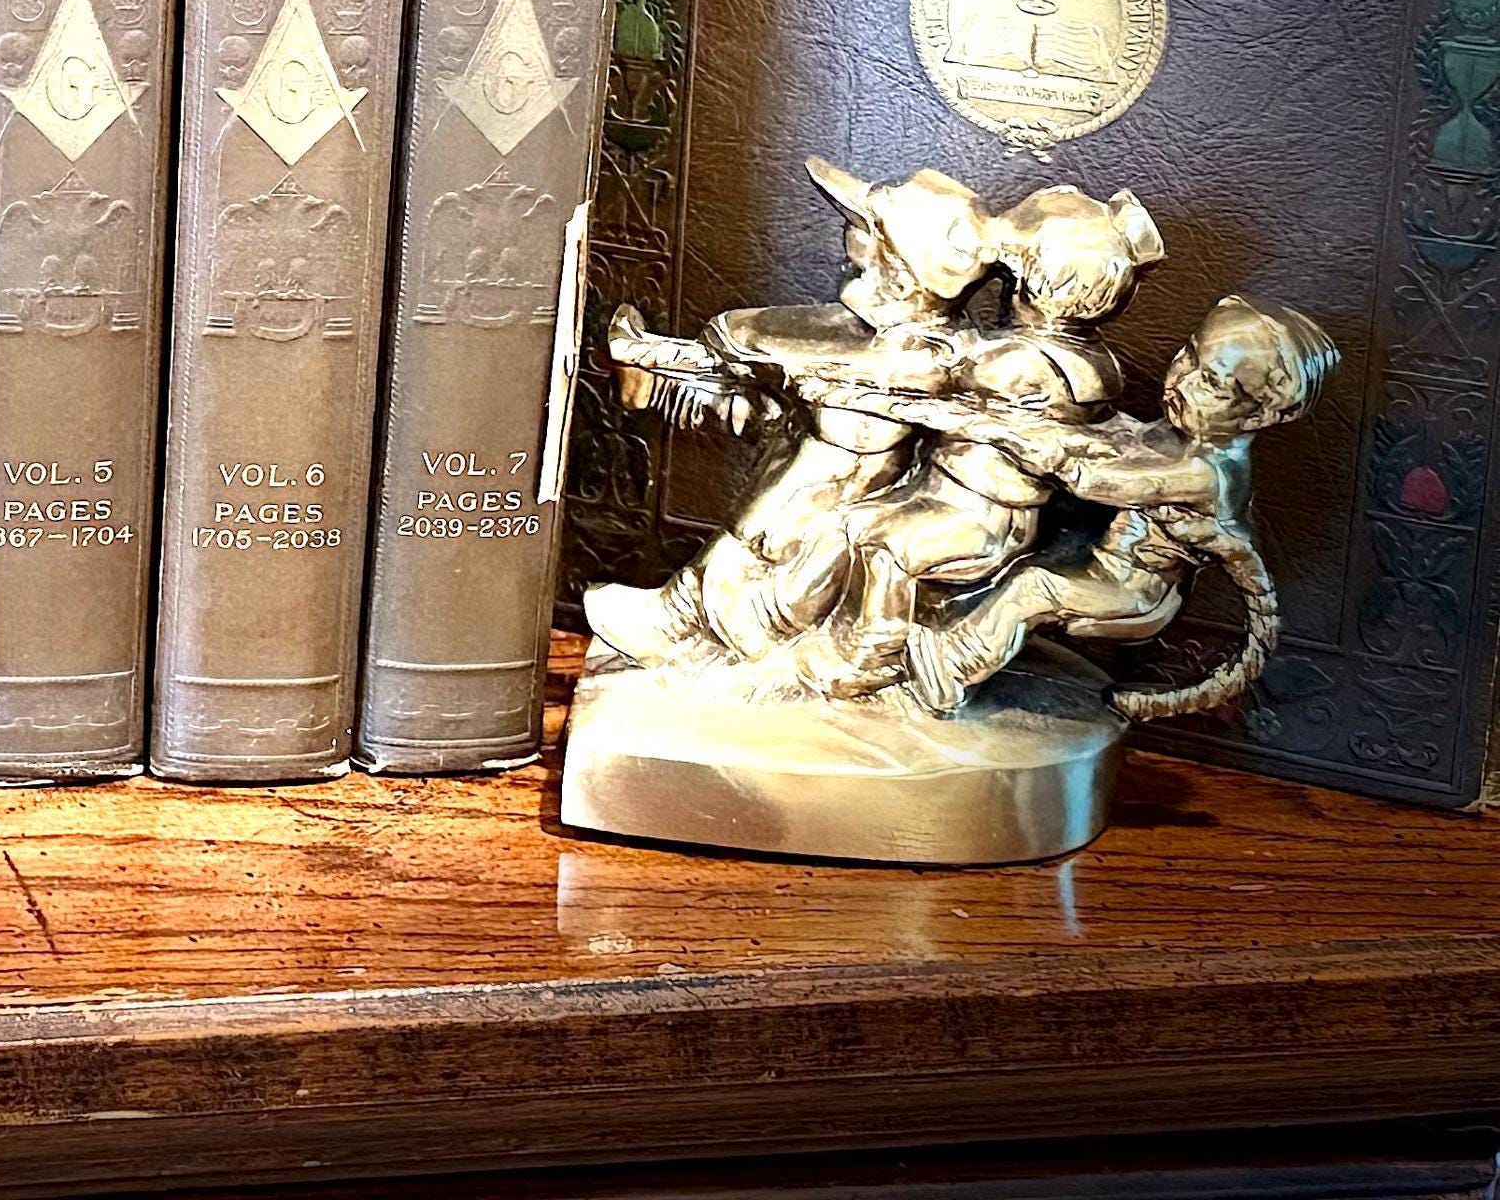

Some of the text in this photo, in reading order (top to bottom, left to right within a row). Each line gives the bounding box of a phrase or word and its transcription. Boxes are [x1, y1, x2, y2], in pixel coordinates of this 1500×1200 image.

[45, 54, 97, 120] G
[265, 58, 315, 124] G
[3, 460, 114, 486] VOL. 5
[219, 463, 326, 487] VOL. 6
[422, 452, 528, 477] VOL. 7
[3, 500, 112, 521] PAGES
[214, 502, 324, 524] PAGES
[417, 491, 522, 512] PAGES
